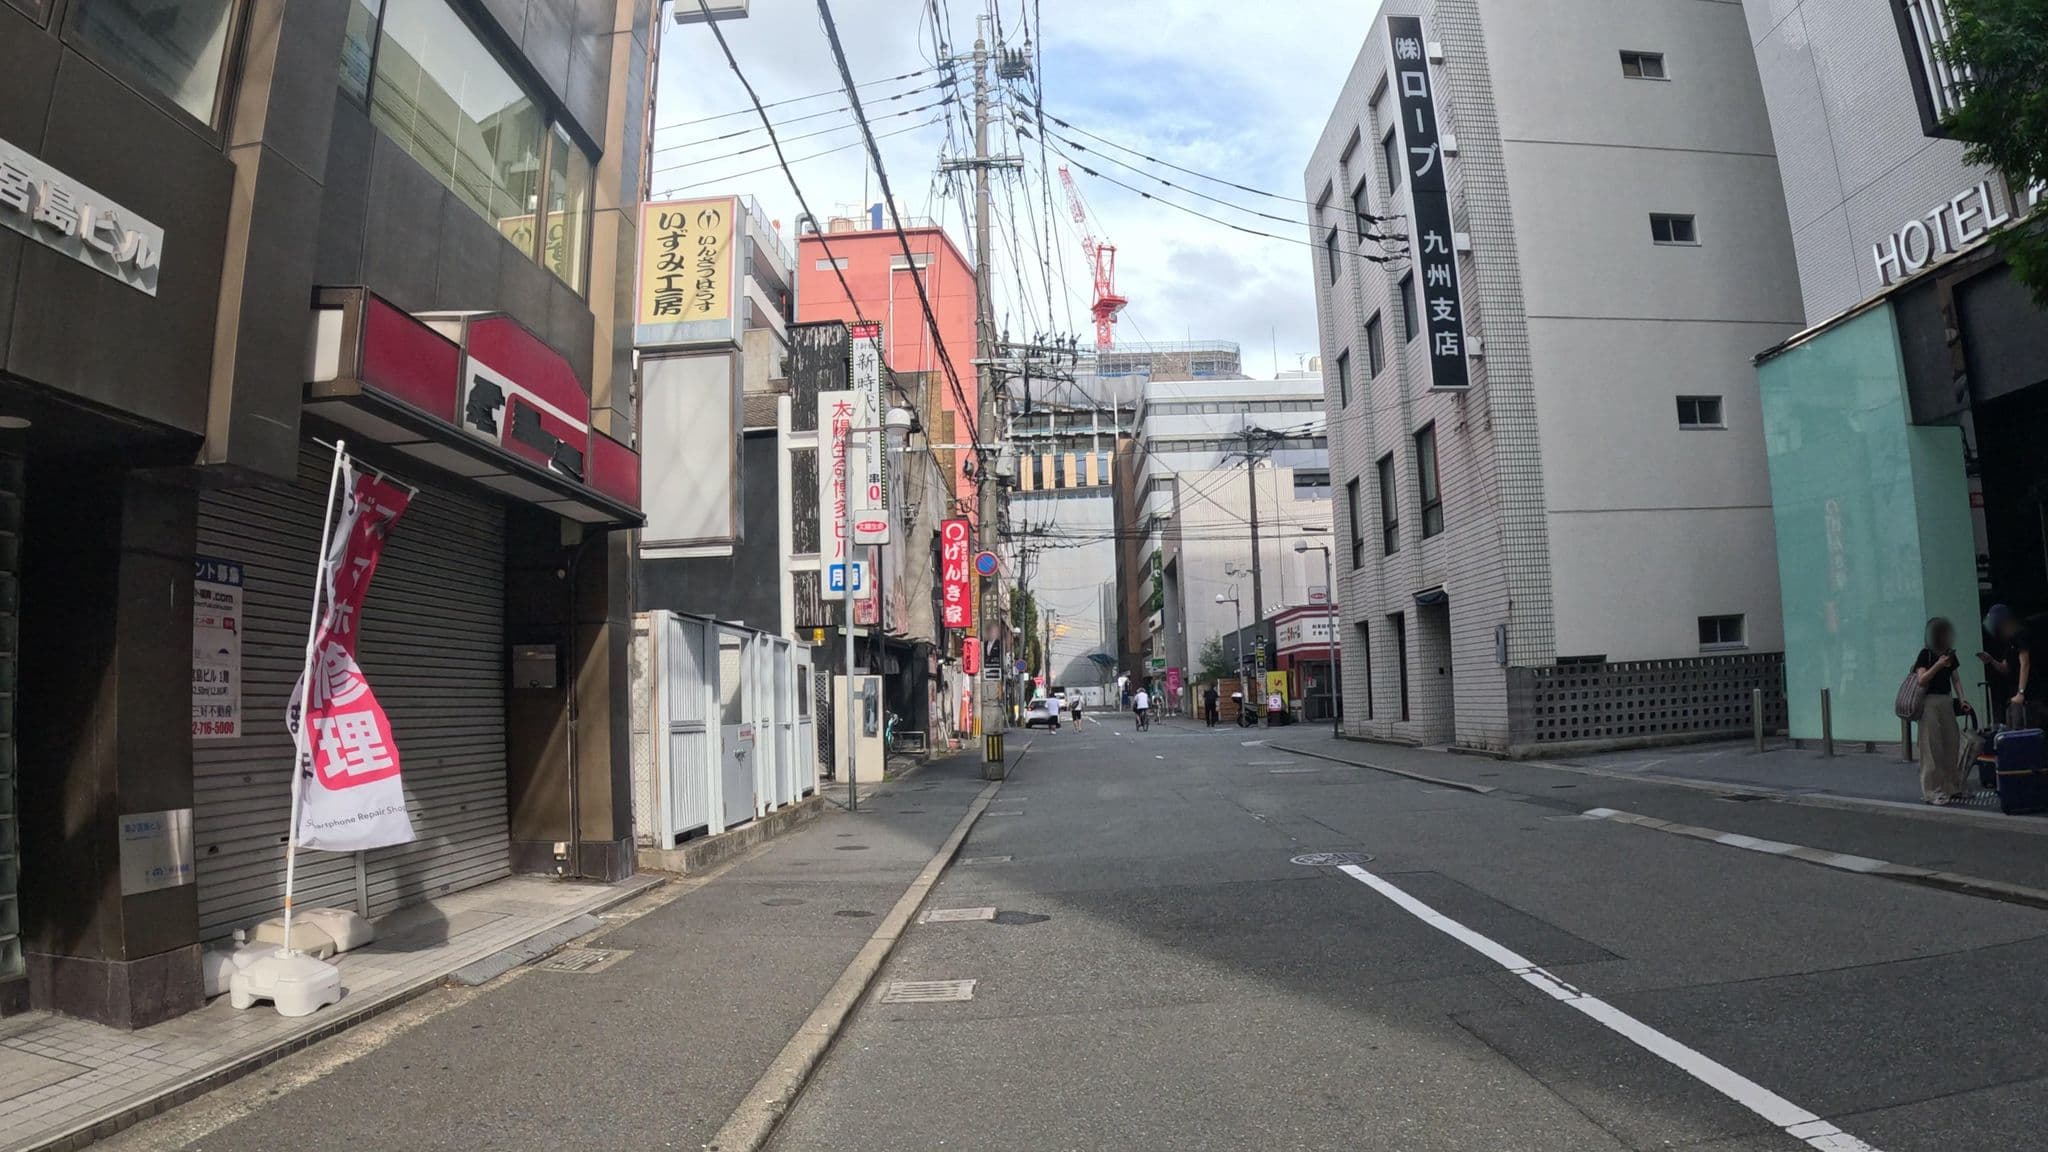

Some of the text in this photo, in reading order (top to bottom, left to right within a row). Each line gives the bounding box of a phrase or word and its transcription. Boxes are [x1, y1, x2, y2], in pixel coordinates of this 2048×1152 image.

[0, 160, 155, 270] 宮島ビル
[653, 212, 688, 316] いずみ工房
[1873, 180, 2009, 286] HOTEL
[1424, 230, 1459, 356] 九州支店
[944, 541, 962, 624] げんき家
[357, 805, 386, 821] Repair
